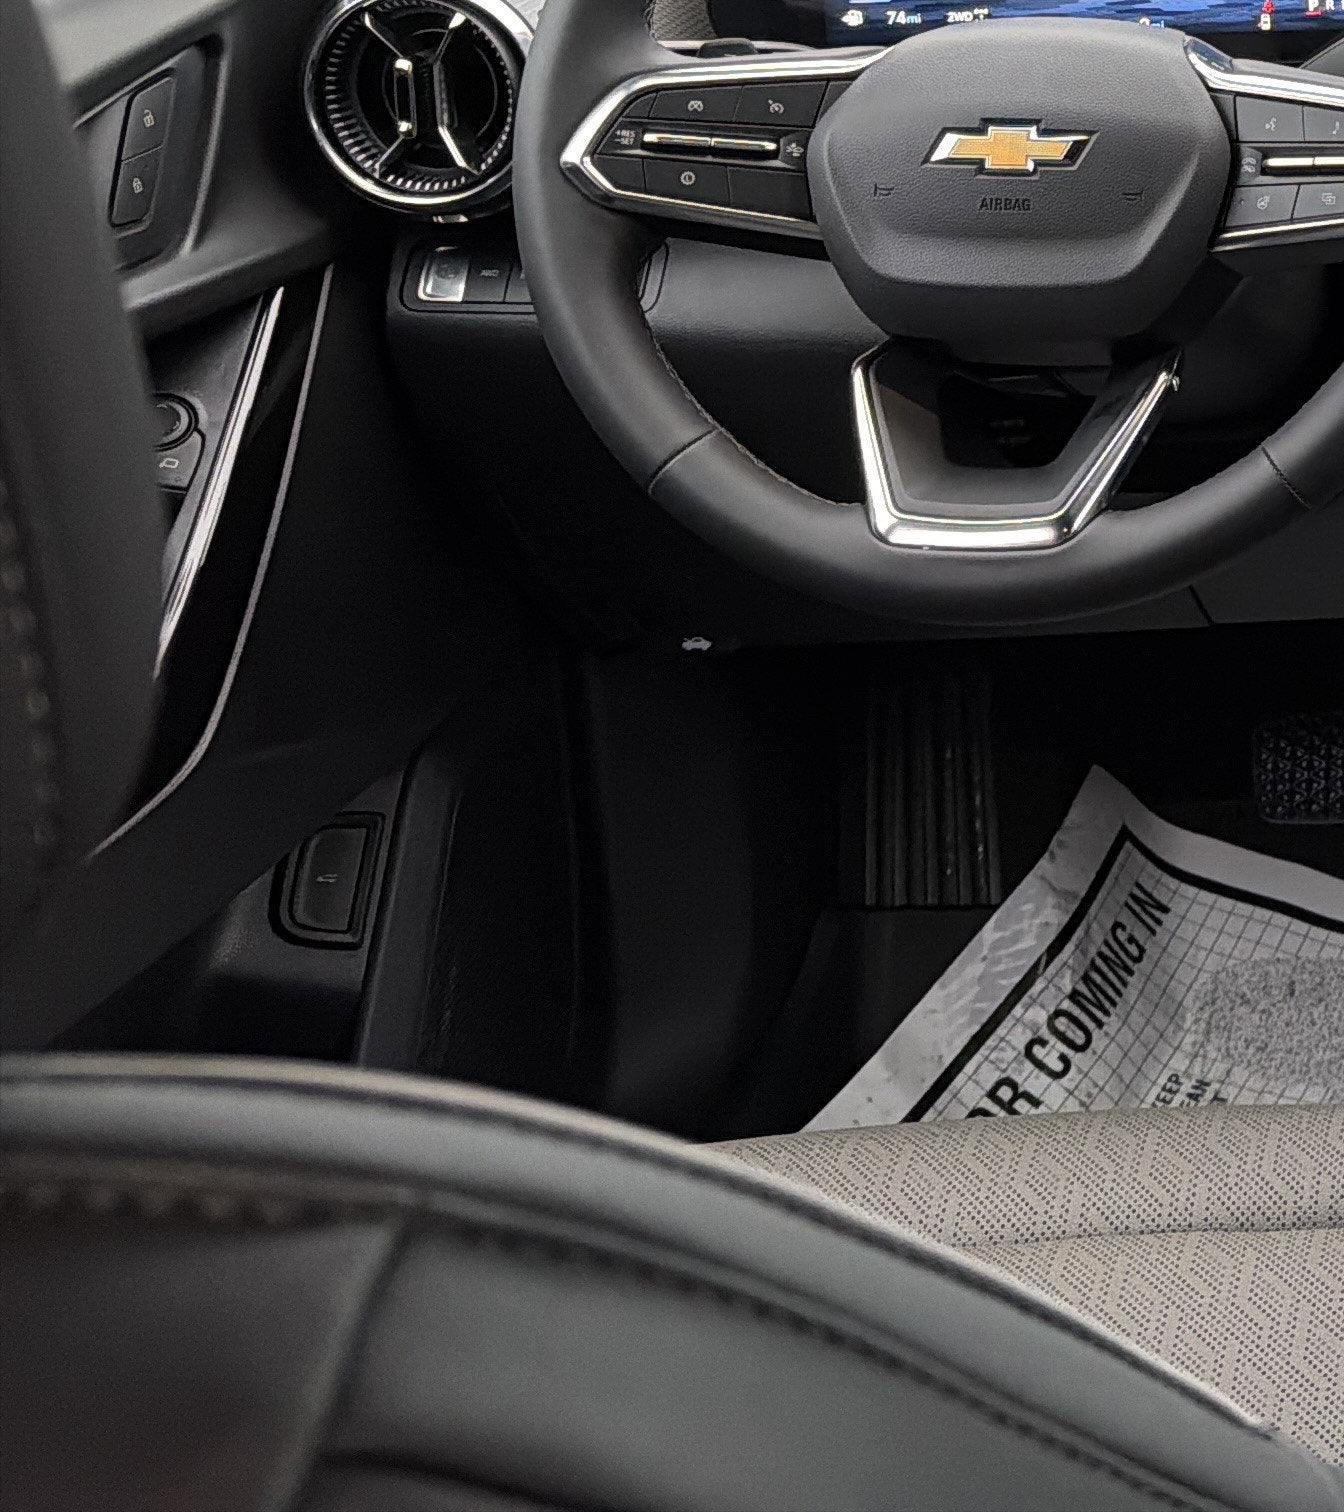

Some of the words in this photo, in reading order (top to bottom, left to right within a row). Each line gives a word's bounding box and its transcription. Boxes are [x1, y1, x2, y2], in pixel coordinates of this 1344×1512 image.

[1325, 0, 1335, 10] R
[979, 197, 1031, 211] AIRBAG
[1024, 920, 1147, 1080] COMING
[1125, 881, 1171, 937] IN
